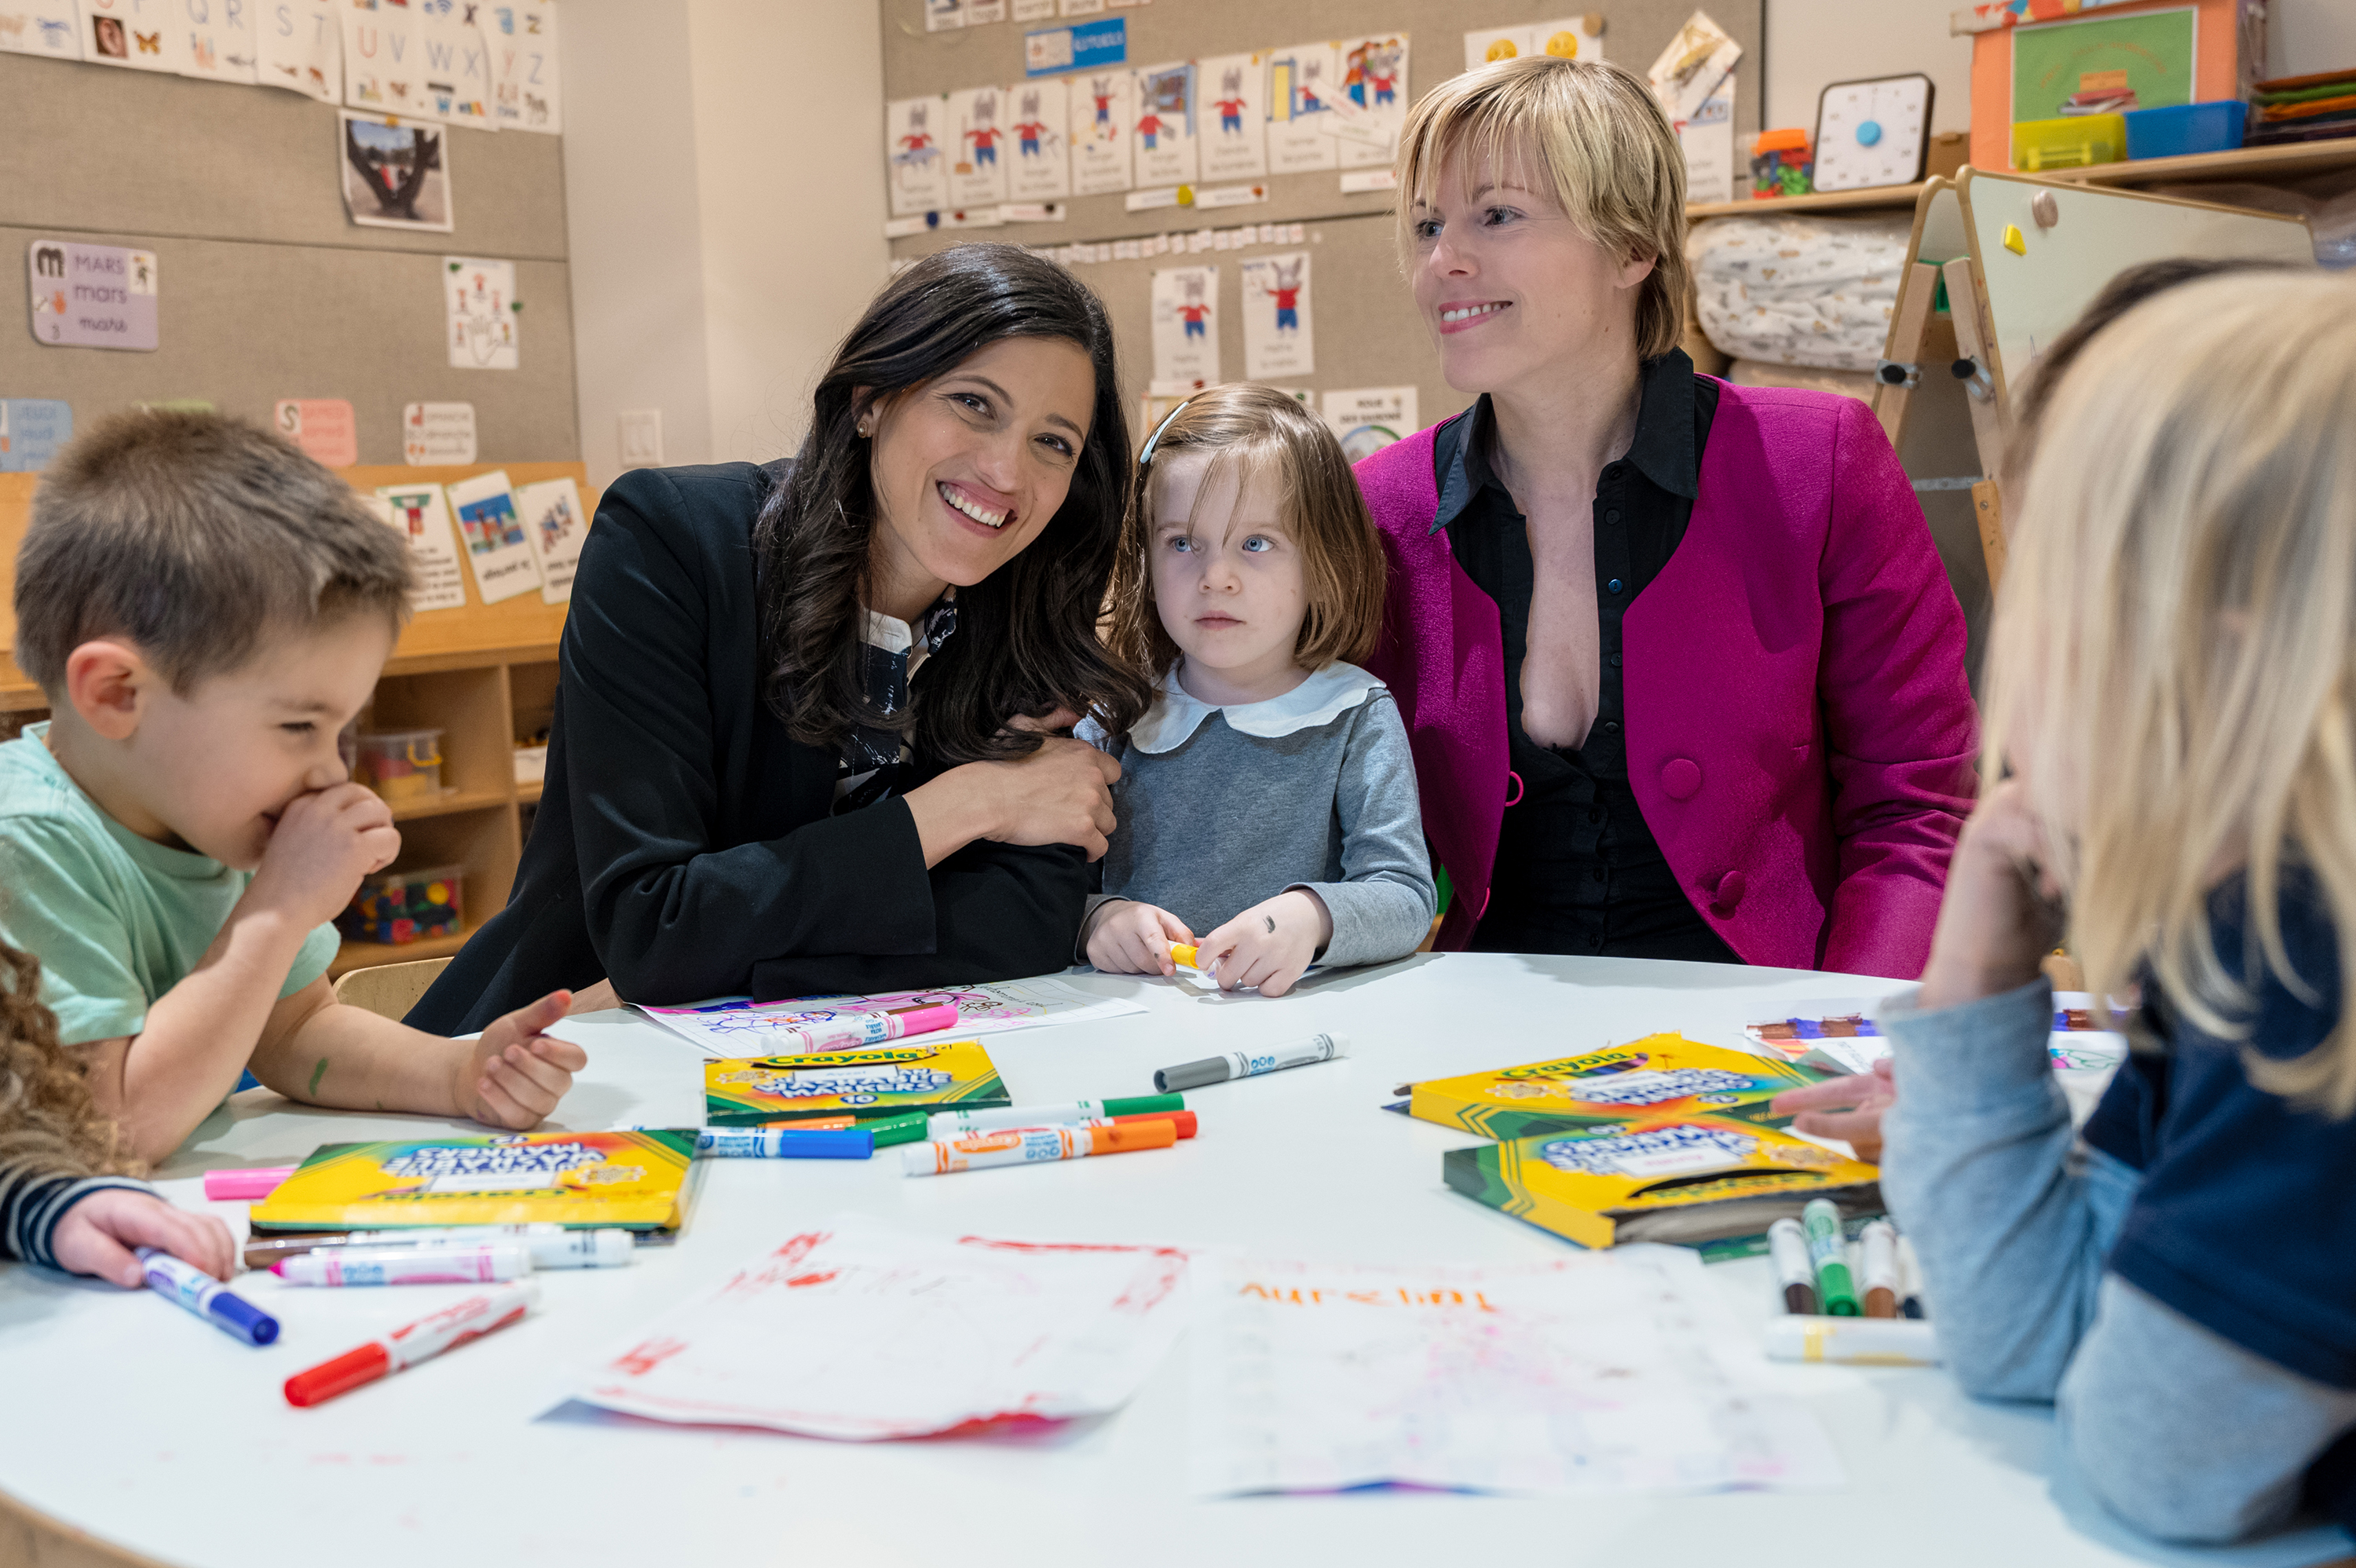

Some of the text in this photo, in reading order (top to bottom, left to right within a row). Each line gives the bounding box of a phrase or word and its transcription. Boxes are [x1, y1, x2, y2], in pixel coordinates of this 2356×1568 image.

[276, 4, 293, 37] S
[357, 25, 406, 64] U V
[426, 39, 479, 79] W X
[503, 48, 545, 85] Y Z
[37, 247, 64, 277] m
[75, 254, 125, 276] MARS
[75, 285, 126, 304] mars
[766, 1051, 919, 1065] Crayola
[1502, 1051, 1630, 1079] Crayola
[782, 1083, 938, 1098] MARKERS
[844, 1095, 876, 1104] 10
[412, 1142, 582, 1160] MARKERS
